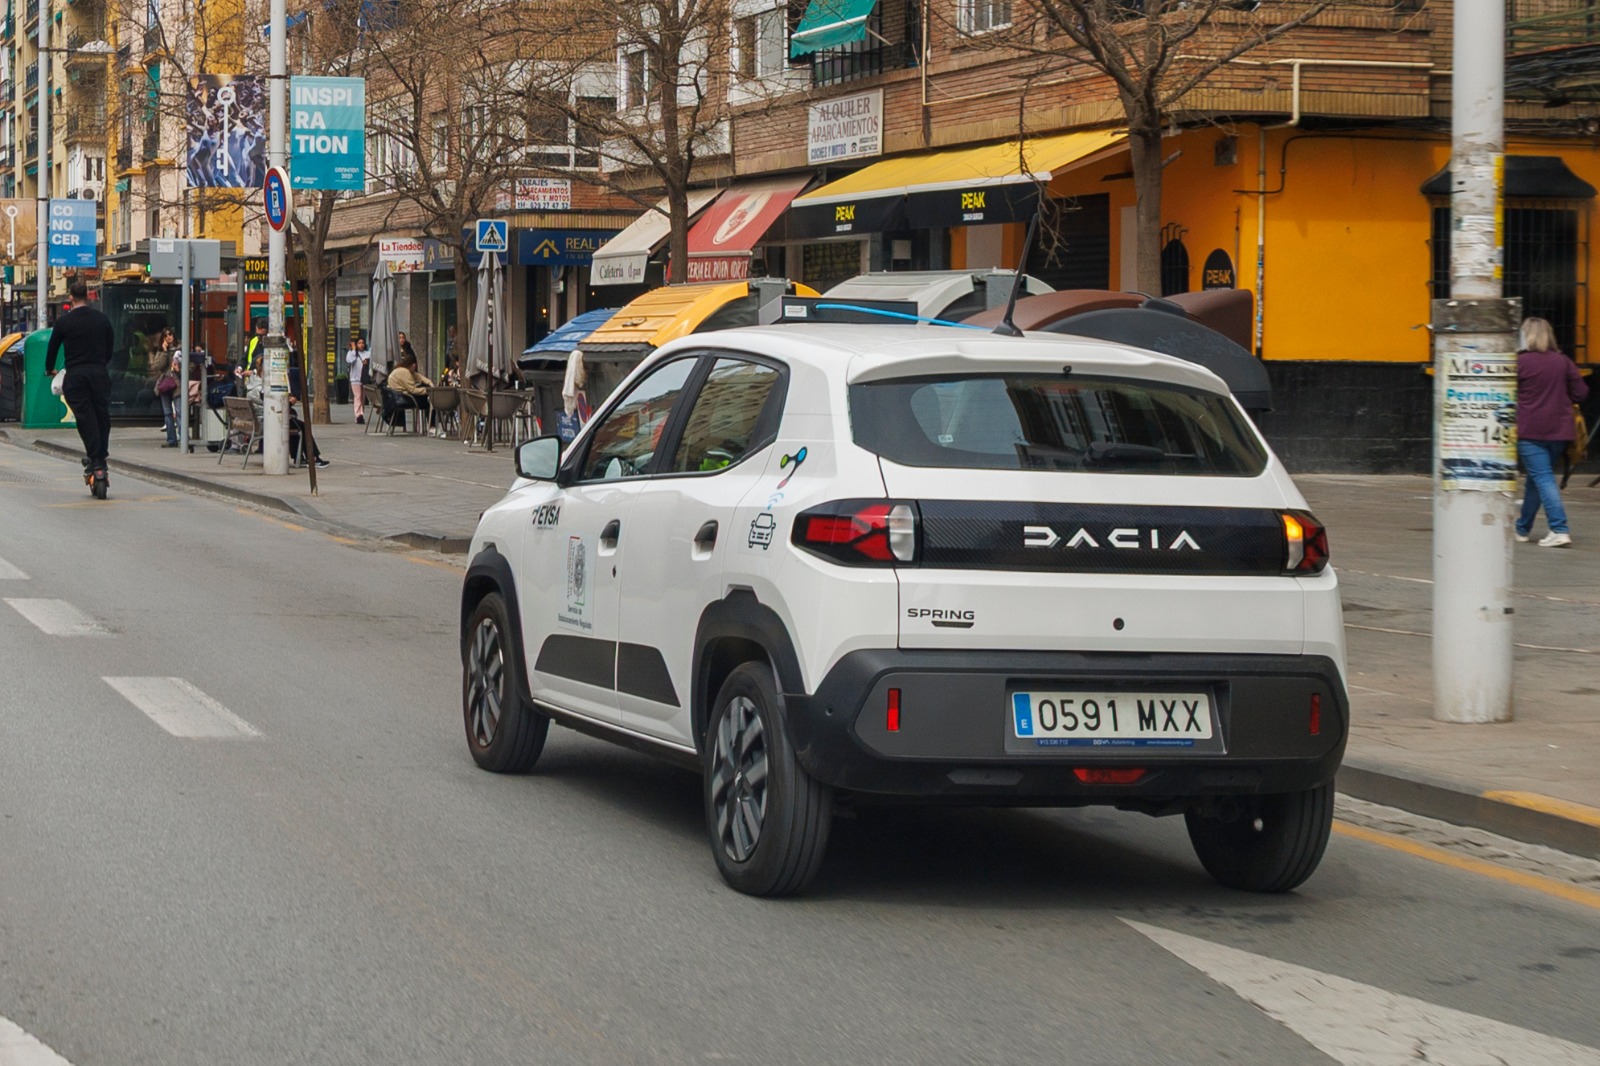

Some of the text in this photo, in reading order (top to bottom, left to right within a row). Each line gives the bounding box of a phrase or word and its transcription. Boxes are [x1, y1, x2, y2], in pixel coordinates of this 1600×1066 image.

[295, 86, 353, 106] INSPI
[819, 97, 871, 122] ALQUILER
[295, 111, 327, 130] RA
[811, 115, 879, 143] APARCAMIENTOS
[295, 135, 349, 154] TION
[961, 191, 986, 209] PEAK
[52, 205, 73, 217] CO
[835, 204, 856, 222] PEAK
[52, 219, 74, 231] NO
[52, 233, 80, 246] CER
[381, 242, 390, 251] La
[565, 237, 596, 250] REAL
[1206, 269, 1231, 284] PEAK
[1446, 388, 1511, 402] Permiso
[1024, 525, 1201, 551] DACIA
[907, 608, 975, 621] SPRING
[1021, 719, 1028, 728] E
[1038, 699, 1202, 732] 0591 MXX
